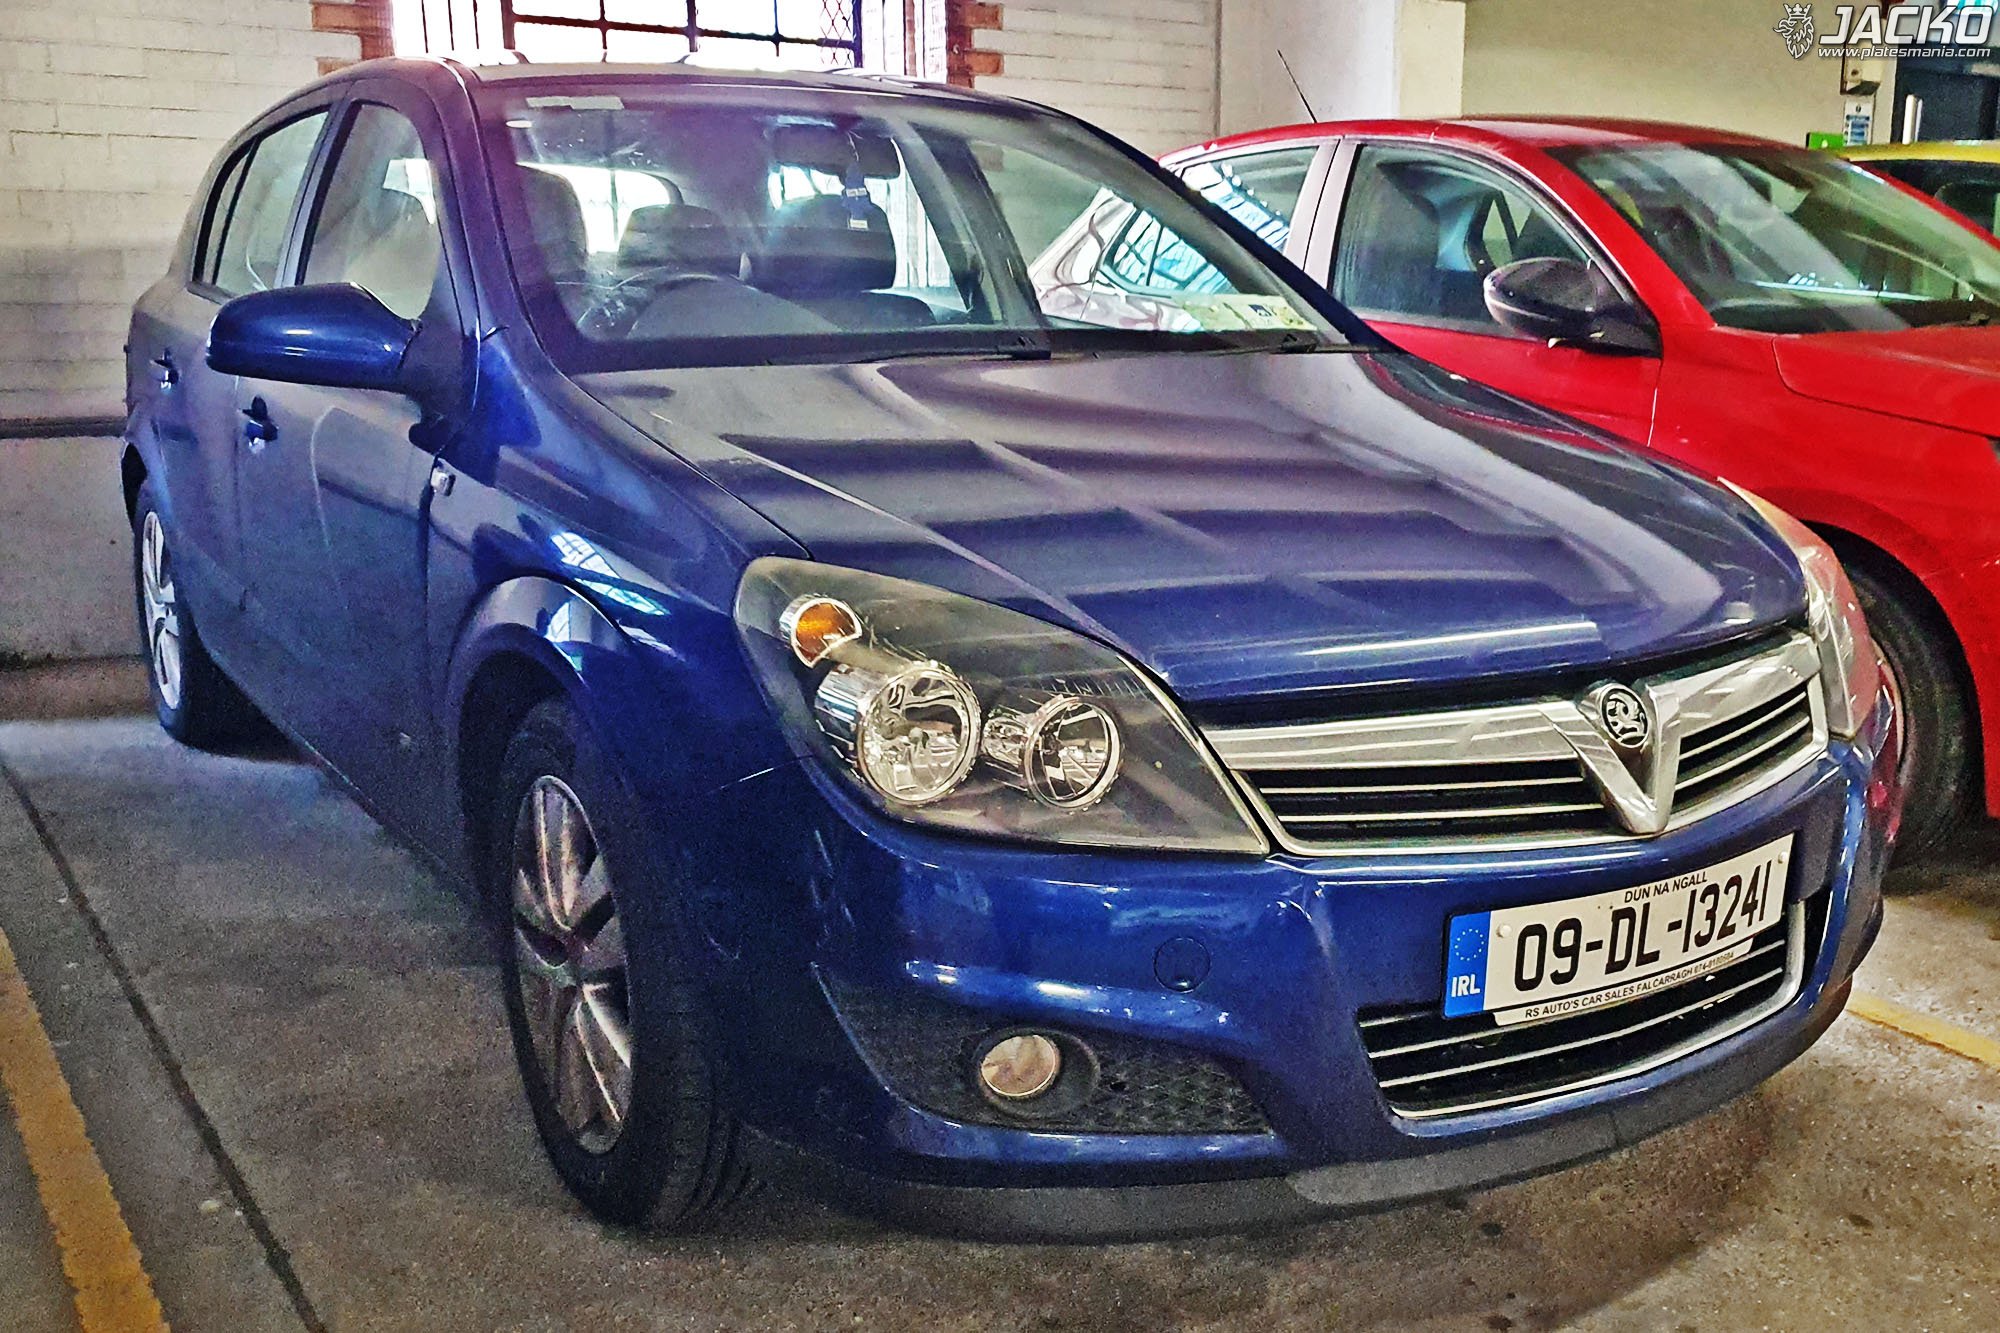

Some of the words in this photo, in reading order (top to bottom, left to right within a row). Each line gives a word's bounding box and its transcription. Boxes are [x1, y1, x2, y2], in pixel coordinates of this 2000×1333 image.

[1653, 881, 1669, 897] NA
[1672, 871, 1708, 892] NGALL
[1514, 860, 1772, 992] 09-DL-13241
[1451, 974, 1480, 998] IRL
[1525, 1007, 1539, 1018] RS
[1542, 1000, 1579, 1015] AUTO'S
[1582, 994, 1602, 1006] CAR
[1604, 986, 1634, 1001] SALES
[1636, 967, 1693, 993] FALCARRAGH
